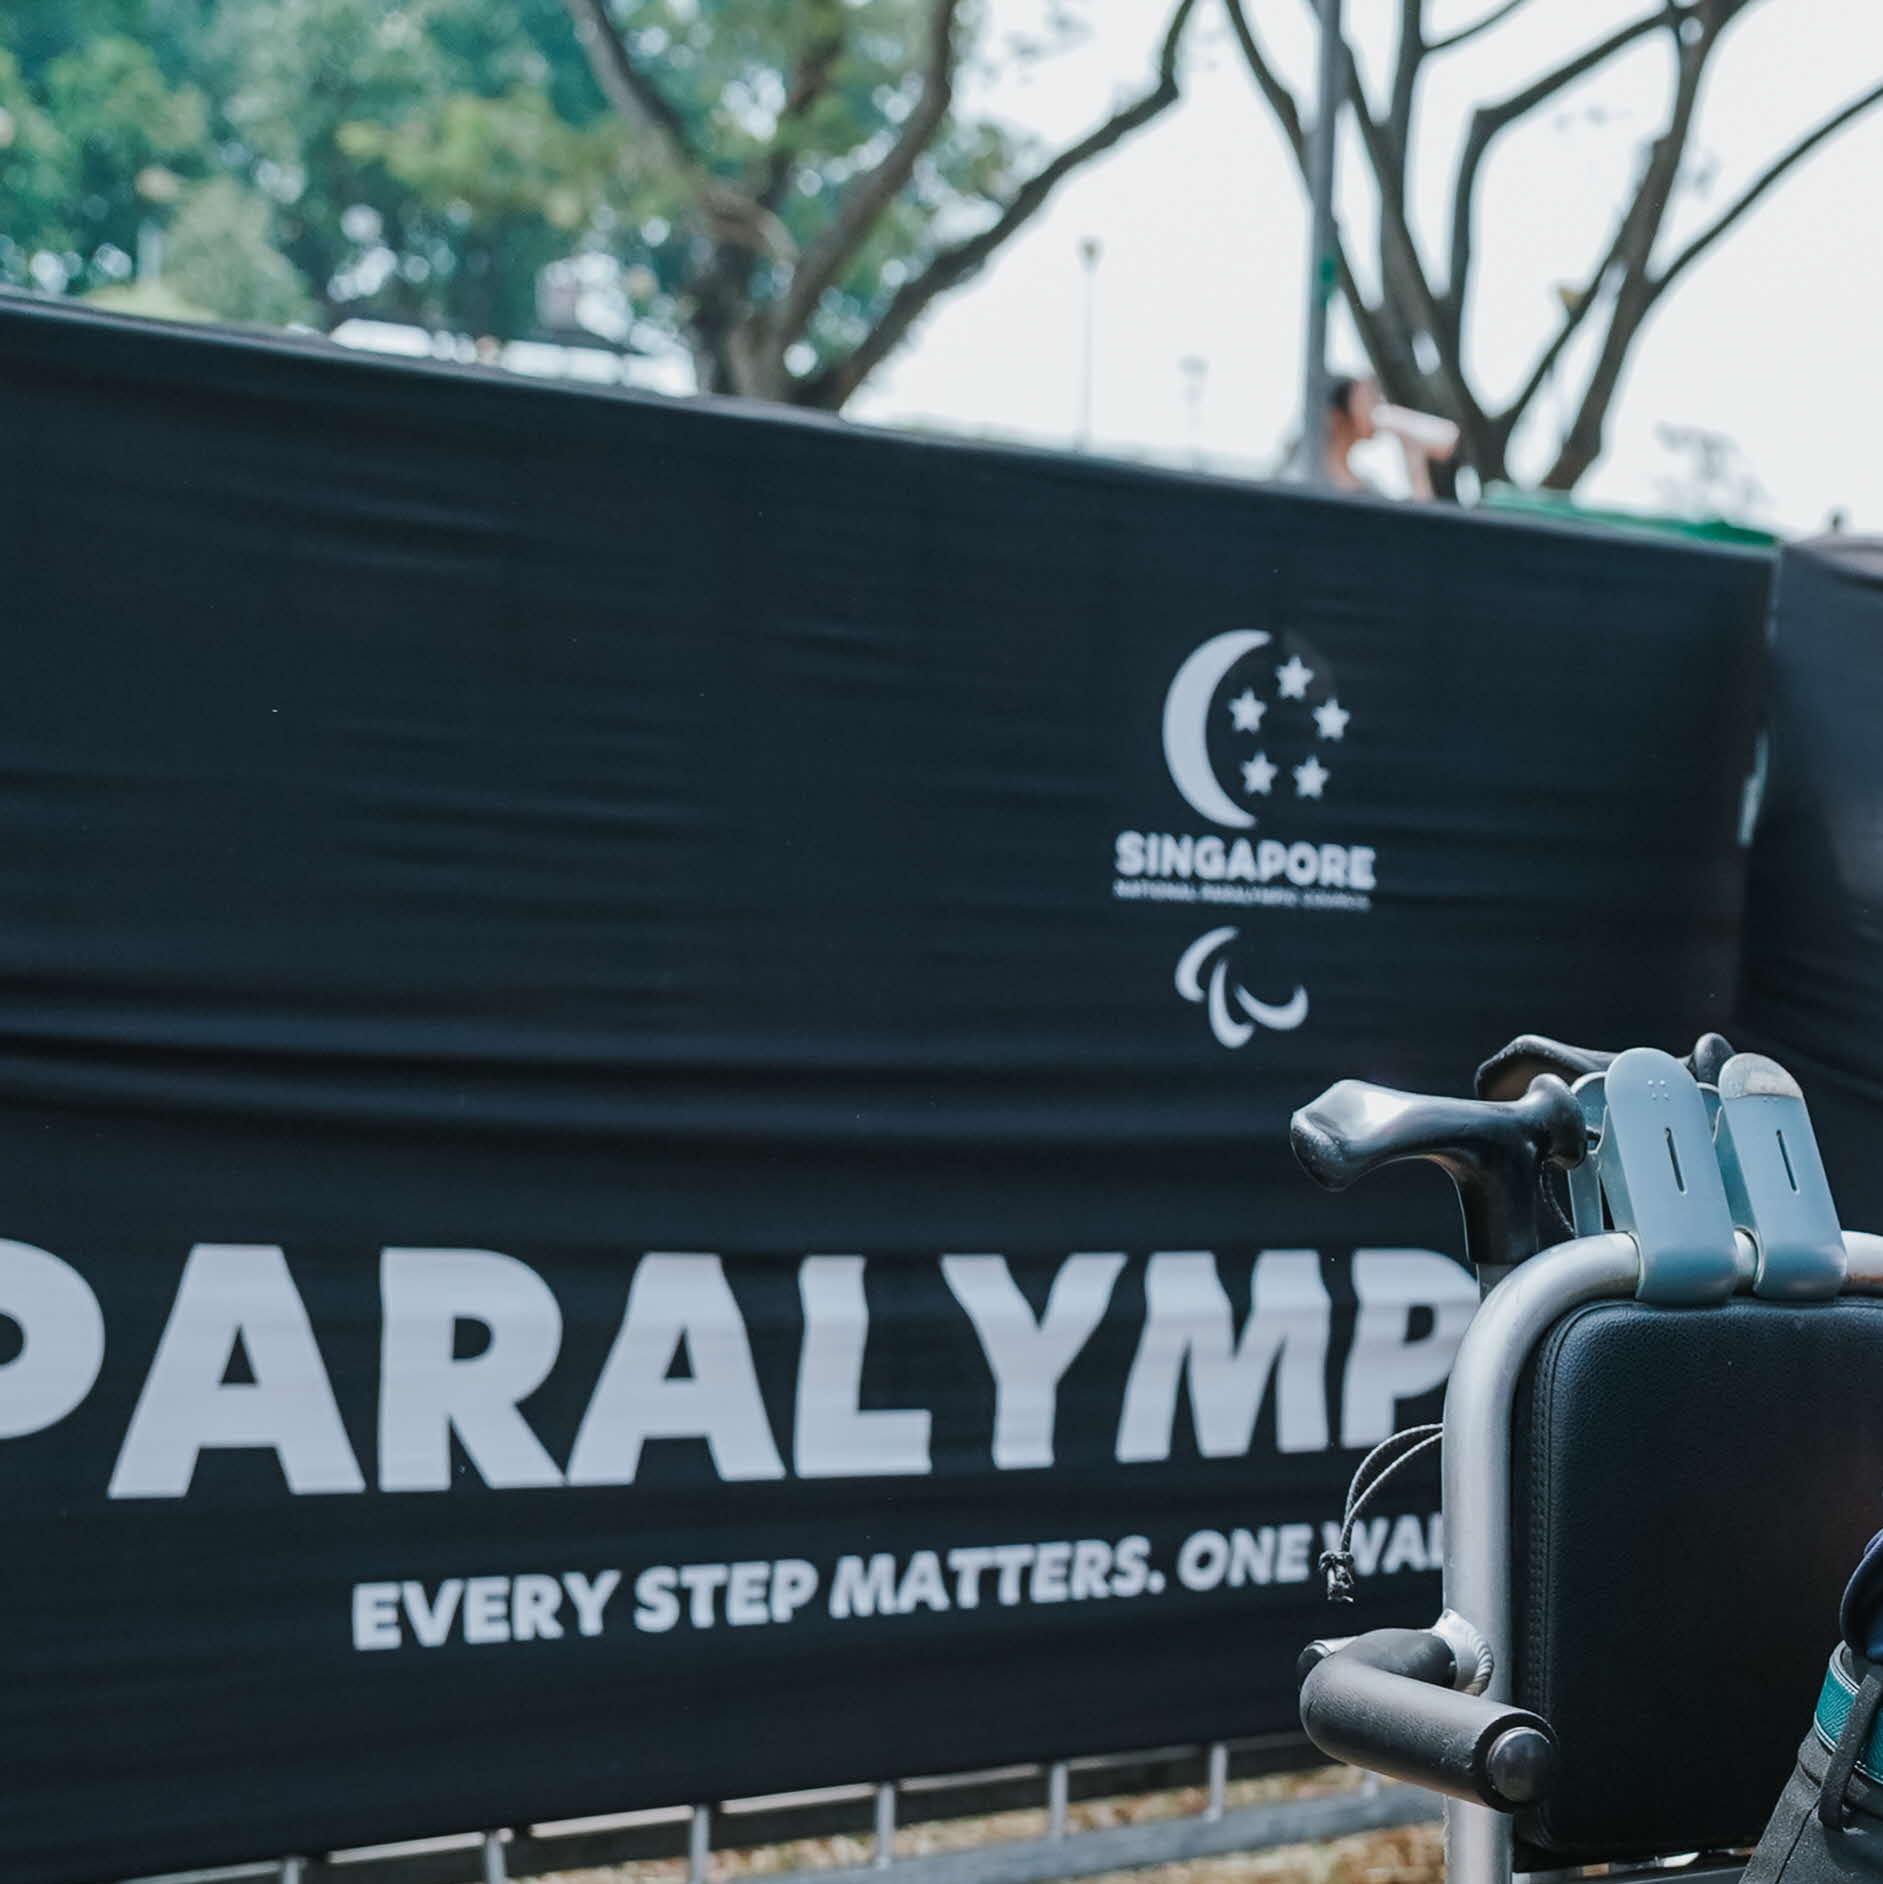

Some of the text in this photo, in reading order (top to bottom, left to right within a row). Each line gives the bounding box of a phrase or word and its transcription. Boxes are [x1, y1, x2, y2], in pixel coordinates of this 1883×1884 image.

[1115, 830, 1377, 891] SINGAPORE
[353, 1569, 621, 1651] EVERY
[634, 1558, 819, 1633] STEP
[829, 1534, 1166, 1619] MATTERS.
[1176, 1523, 1313, 1592] ONE
